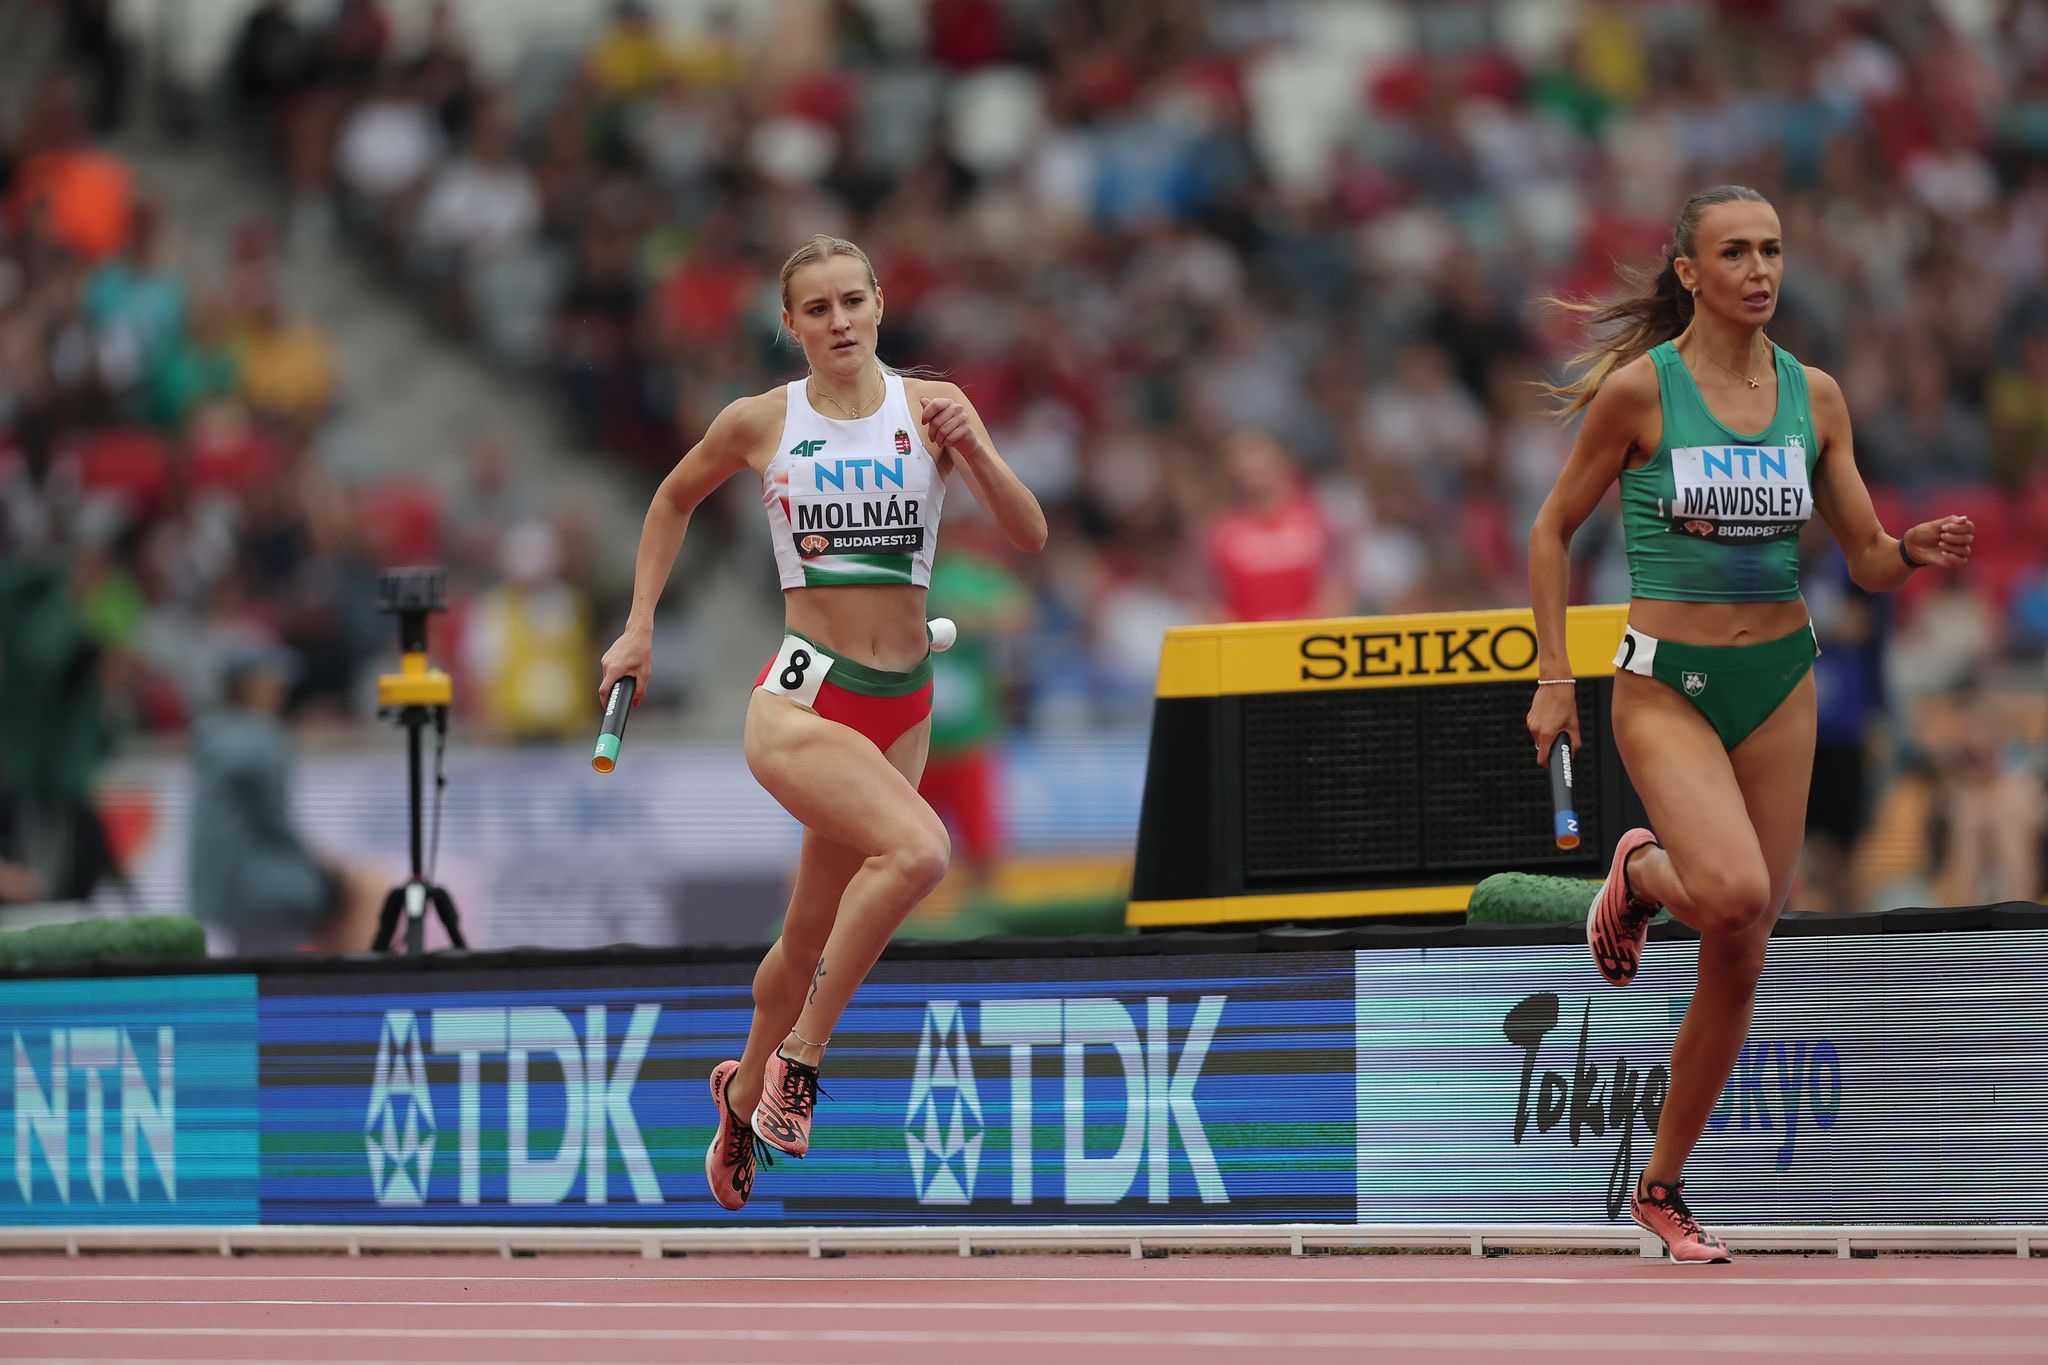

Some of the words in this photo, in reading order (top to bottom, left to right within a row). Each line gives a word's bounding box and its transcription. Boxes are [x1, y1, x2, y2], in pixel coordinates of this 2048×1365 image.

[815, 457, 904, 492] NTN
[1702, 447, 1787, 480] NTN
[798, 494, 919, 530] MOLNÁR
[1683, 486, 1804, 517] MAWDSLEY
[780, 648, 811, 690] 8
[1300, 626, 1538, 681] SEIKO
[1561, 744, 1573, 781] MONDO
[13, 1025, 176, 1206] NTN
[432, 1003, 664, 1204] TDK
[980, 995, 1230, 1204] TDK
[1503, 991, 1668, 1220] Tokyo
